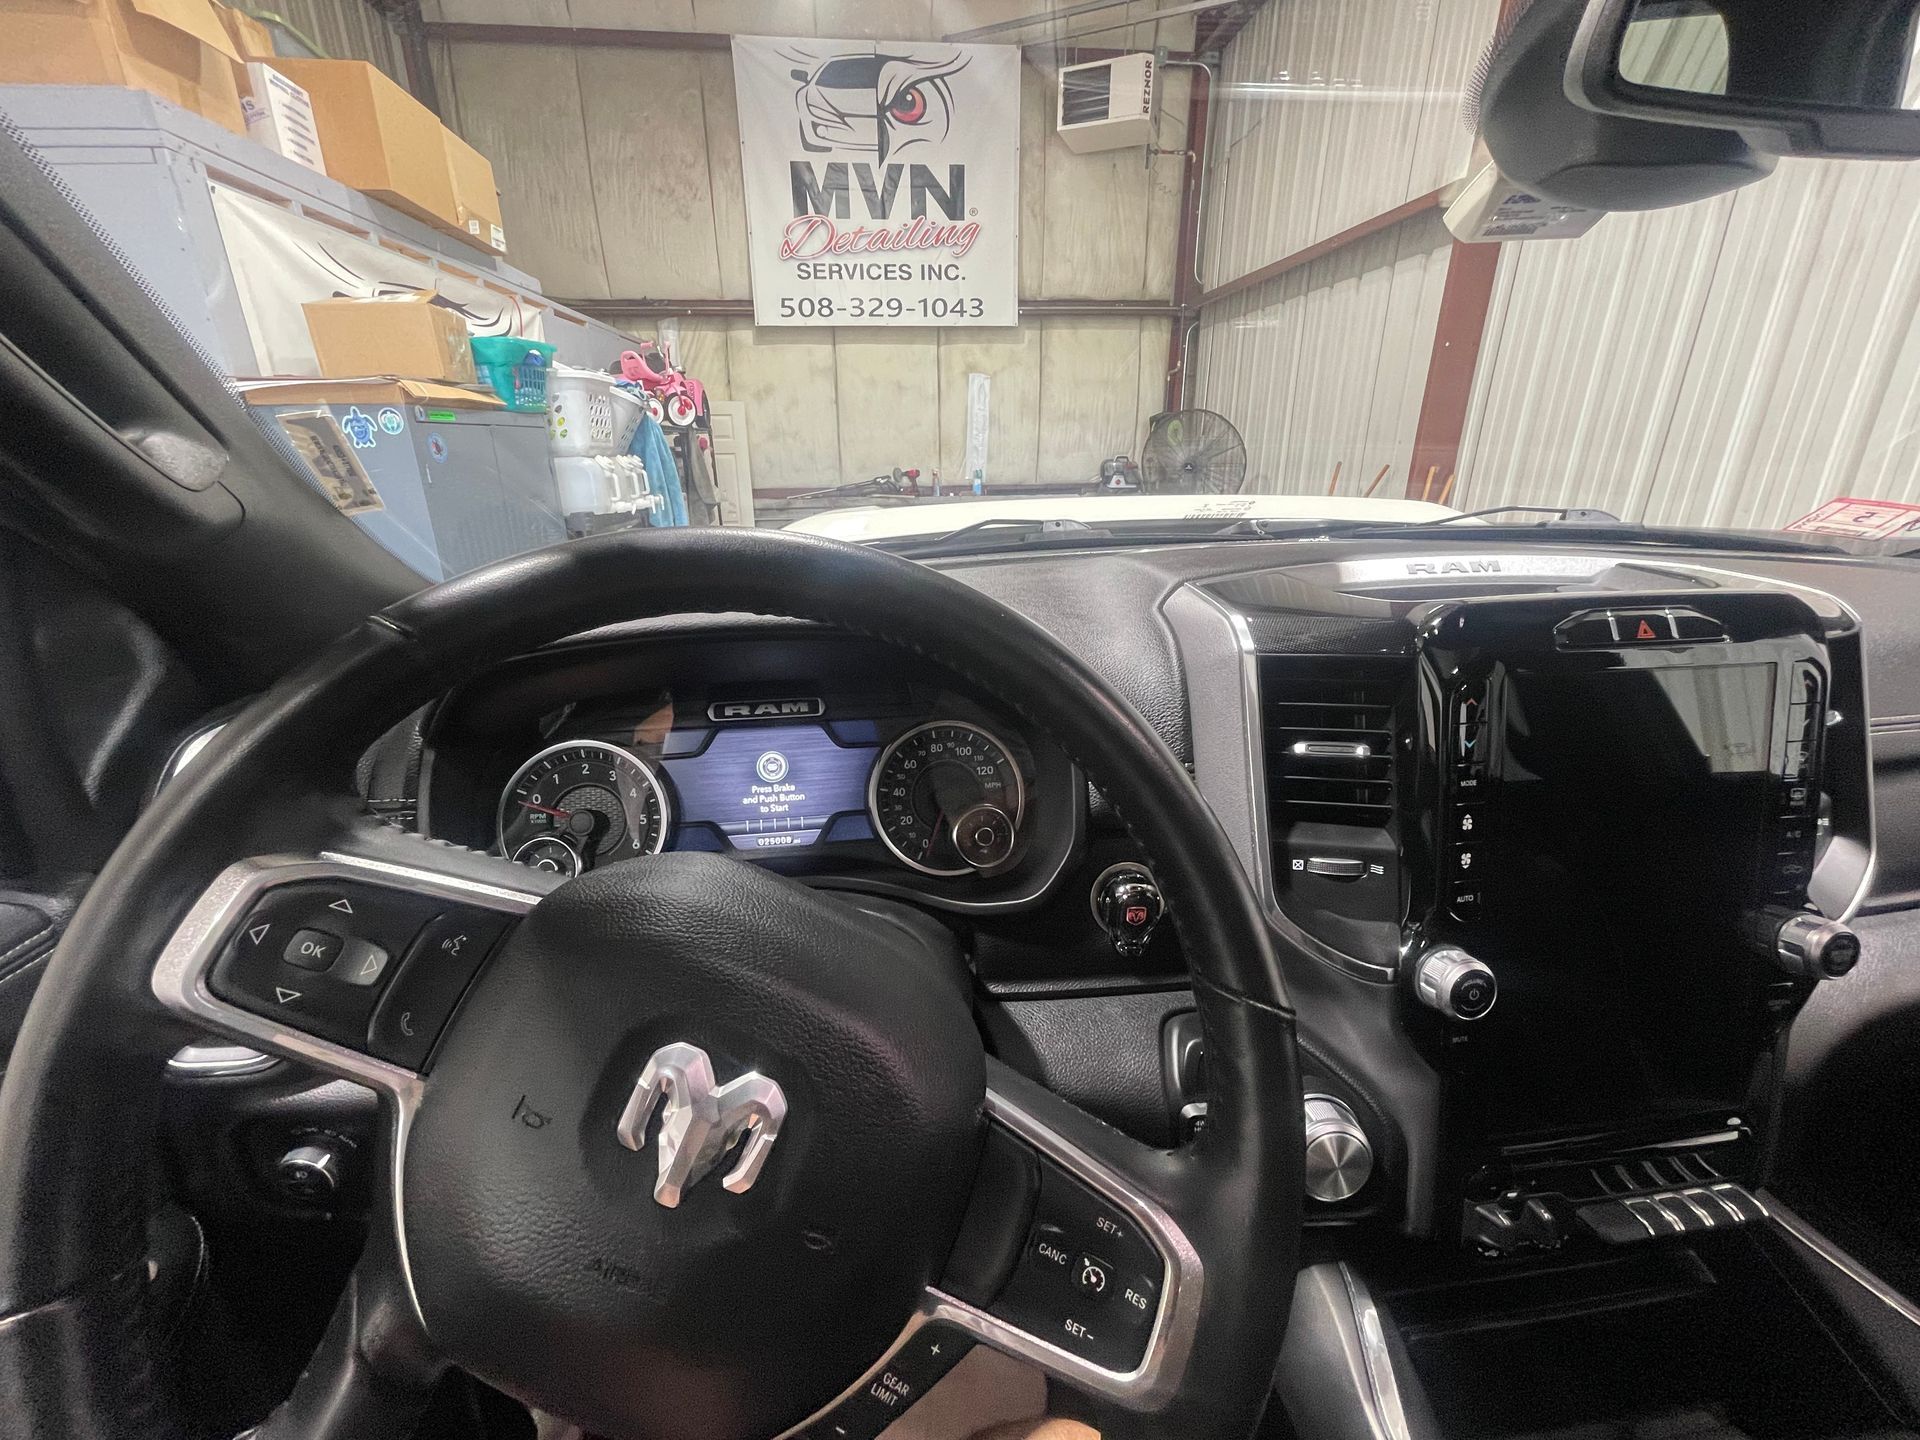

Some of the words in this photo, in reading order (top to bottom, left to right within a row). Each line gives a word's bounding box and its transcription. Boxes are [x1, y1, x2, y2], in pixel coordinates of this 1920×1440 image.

[1143, 60, 1152, 113] REZNOR
[790, 161, 965, 221] MVN
[779, 215, 981, 261] Detailing
[797, 263, 912, 280] SERVICES
[920, 264, 966, 280] INC.
[780, 297, 984, 318] 508-329-1043
[1406, 560, 1501, 575] RAM
[724, 702, 809, 716] RAM
[930, 744, 943, 753] 80
[955, 747, 972, 756] 100
[581, 764, 590, 775] 2
[904, 760, 917, 769] 60
[609, 770, 617, 781] 3
[976, 766, 994, 775] 120
[552, 773, 560, 785] 1
[629, 787, 637, 798] 4
[751, 785, 772, 794] Press
[773, 783, 796, 793] Brake
[893, 788, 906, 796] 40
[532, 793, 542, 805] 0
[742, 795, 758, 805] and
[759, 794, 778, 803] Push
[779, 793, 806, 802] Button
[760, 805, 769, 813] to
[770, 803, 789, 812] Start
[530, 812, 546, 820] RPM
[639, 814, 647, 825] 5
[900, 816, 913, 825] 20
[632, 840, 640, 851] 6
[922, 839, 929, 848] 0
[1457, 894, 1474, 903] AUTO
[300, 941, 327, 958] OK
[1096, 1217, 1123, 1237] SET+
[1039, 1243, 1067, 1265] CANC
[1124, 1288, 1147, 1310] RES
[883, 1372, 910, 1396] GEAR
[870, 1383, 898, 1406] LIMIT
